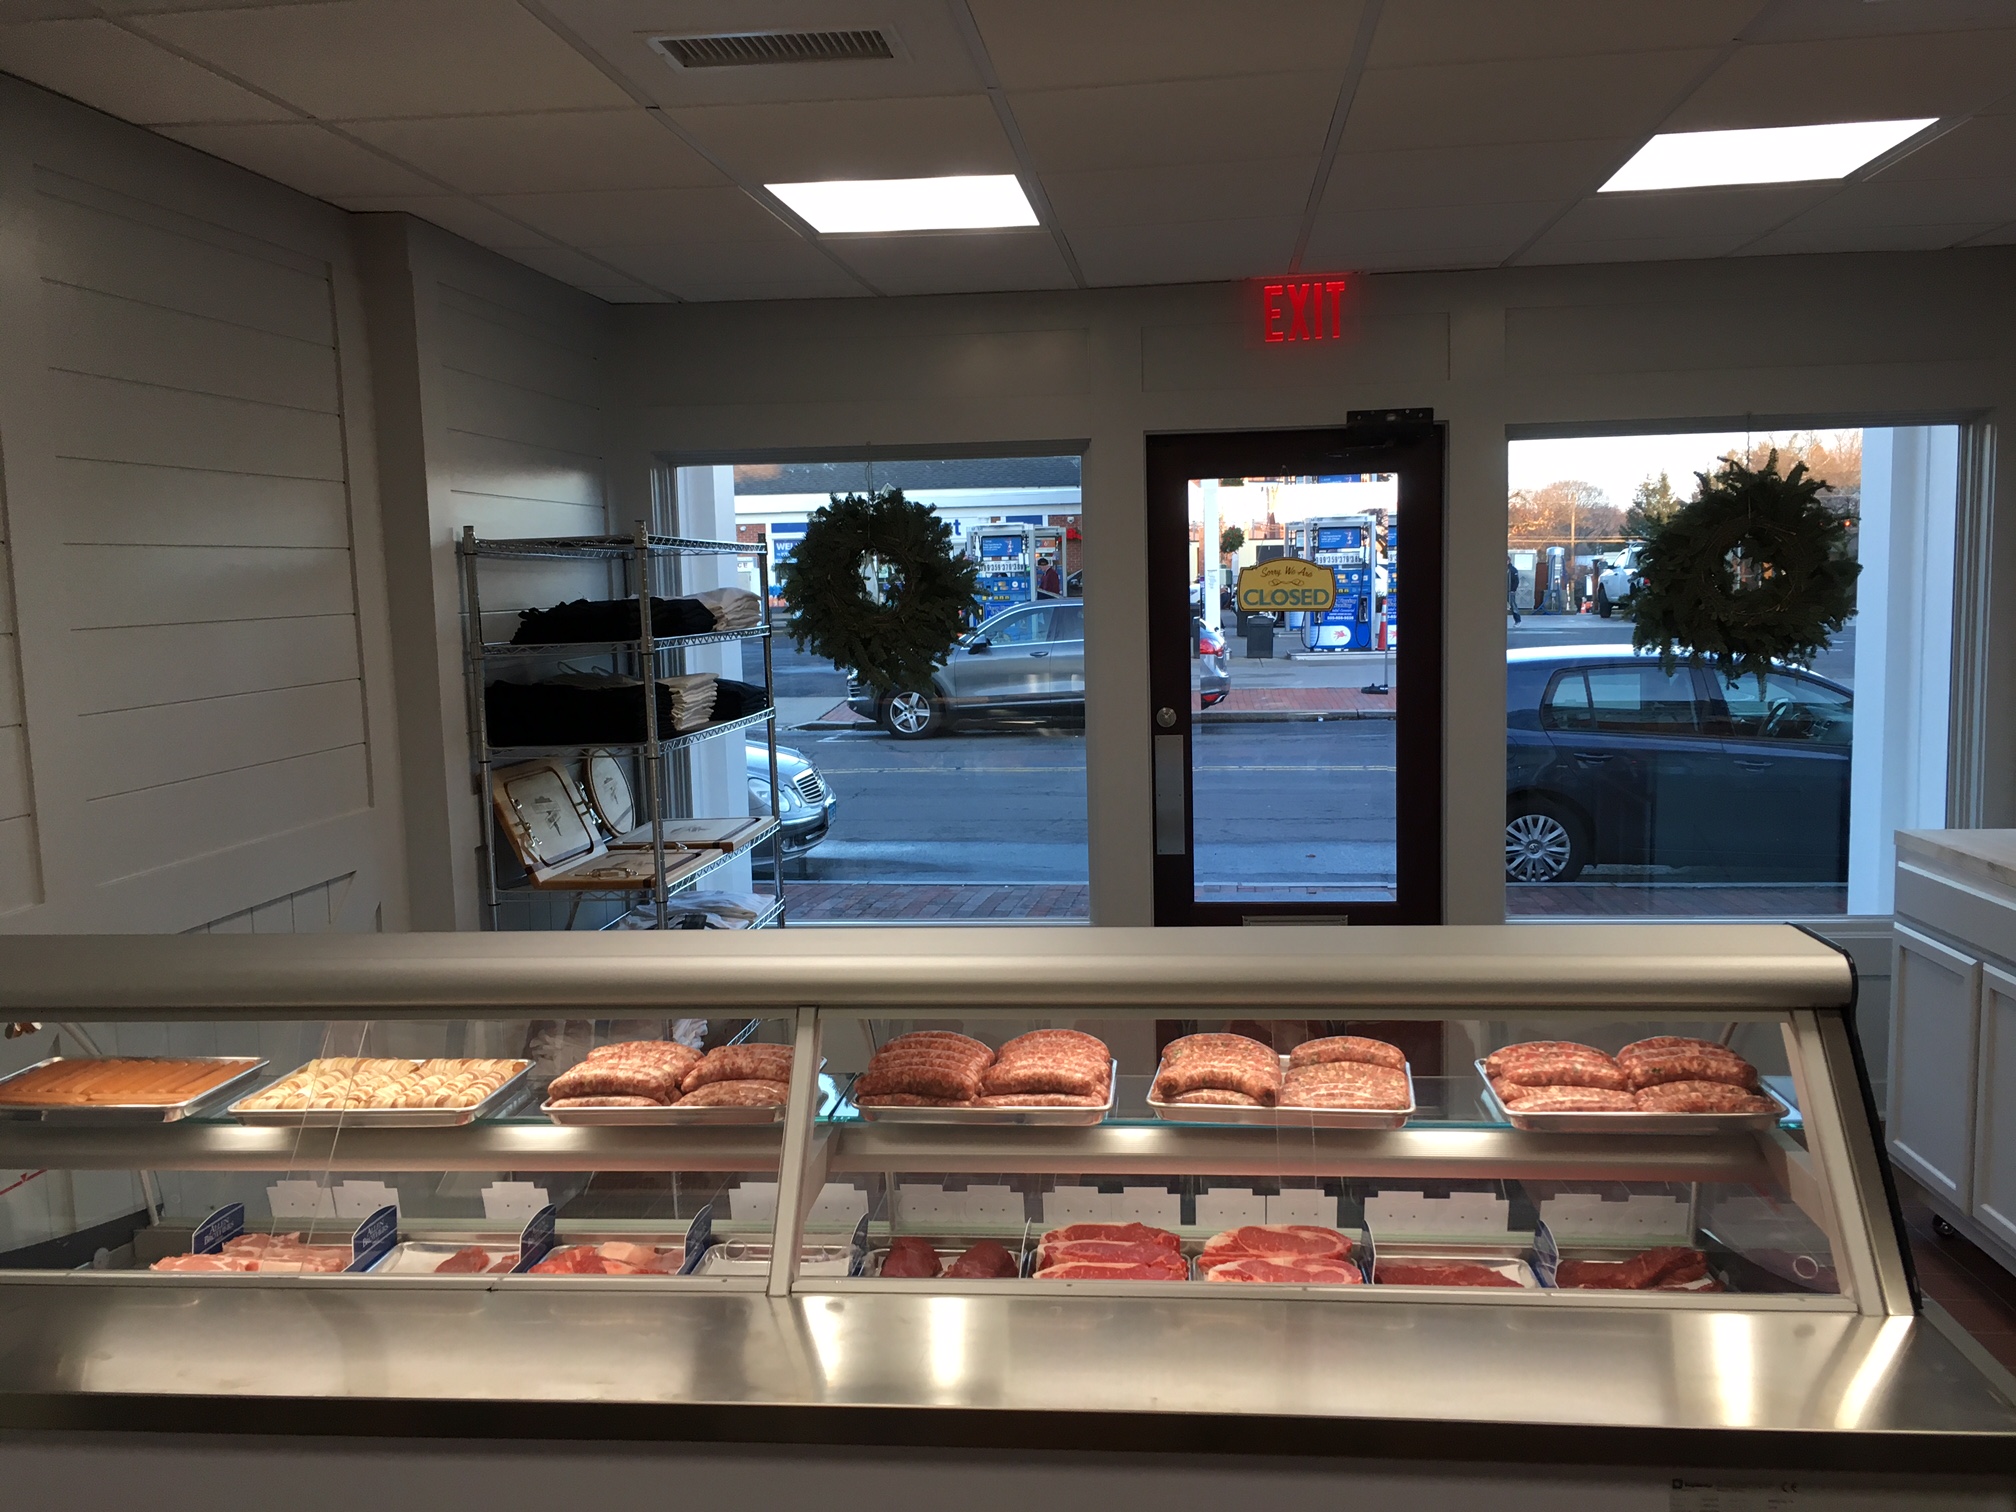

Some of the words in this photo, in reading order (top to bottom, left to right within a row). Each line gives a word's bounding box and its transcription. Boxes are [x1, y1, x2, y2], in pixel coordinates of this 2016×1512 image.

[1263, 281, 1346, 343] EXIT
[1260, 566, 1281, 578] Sorry
[1285, 566, 1296, 575] We
[1298, 567, 1313, 578] Are
[1243, 588, 1330, 606] CLOSED
